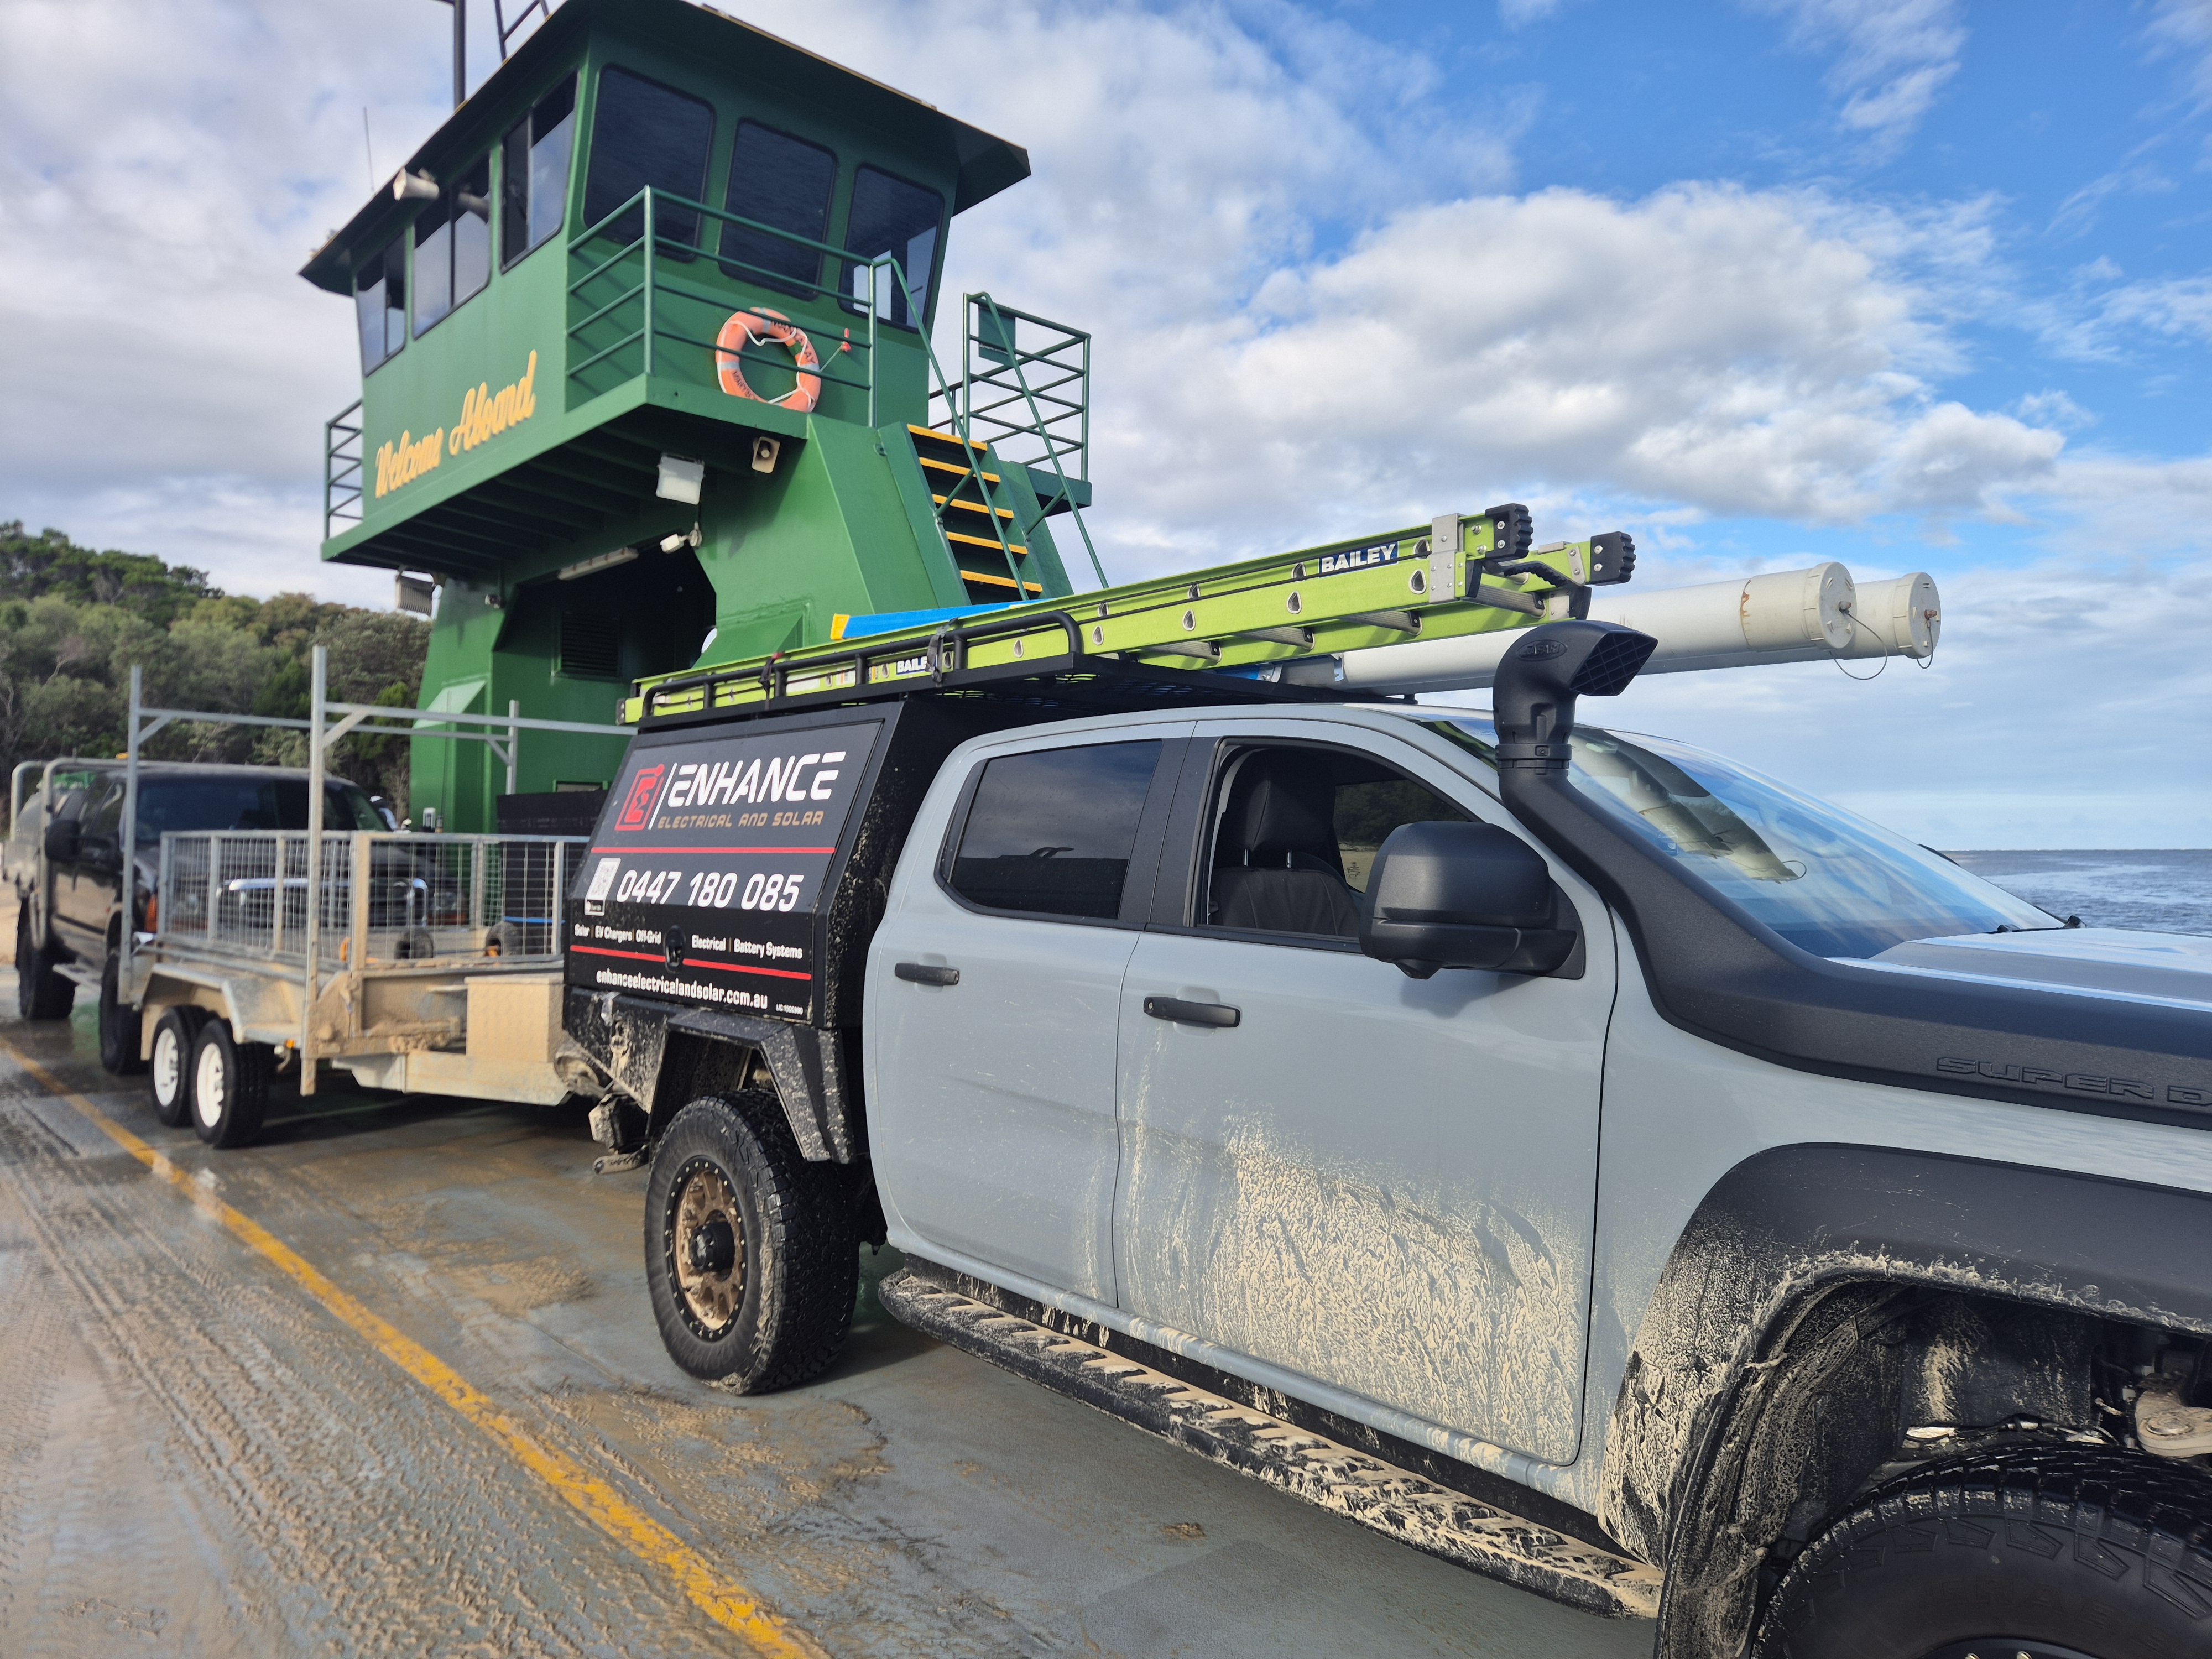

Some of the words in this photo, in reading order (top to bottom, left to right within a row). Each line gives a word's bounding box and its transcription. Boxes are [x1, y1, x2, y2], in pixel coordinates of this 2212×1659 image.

[375, 426, 444, 499] Welcome
[449, 349, 537, 456] Aboard
[1321, 543, 1396, 573] BAILEY
[896, 656, 927, 673] BAILE
[667, 751, 846, 807] ENHANCE
[658, 814, 732, 829] ELECTRICAL
[738, 812, 768, 827] AND
[772, 810, 824, 826] SOLAR
[616, 870, 682, 905] 0447
[687, 872, 738, 909] 180
[741, 873, 805, 912] 085
[574, 923, 590, 937] Solar
[595, 925, 604, 938] EV
[604, 926, 633, 943] Chargers
[636, 929, 661, 945] Off-Grid
[691, 934, 727, 952] Electrical
[734, 938, 765, 959] Battery
[766, 941, 803, 960] Systems
[596, 967, 768, 1010] enhanceelectricalandsolar.com.au
[1937, 1056, 2154, 1100] SUPER
